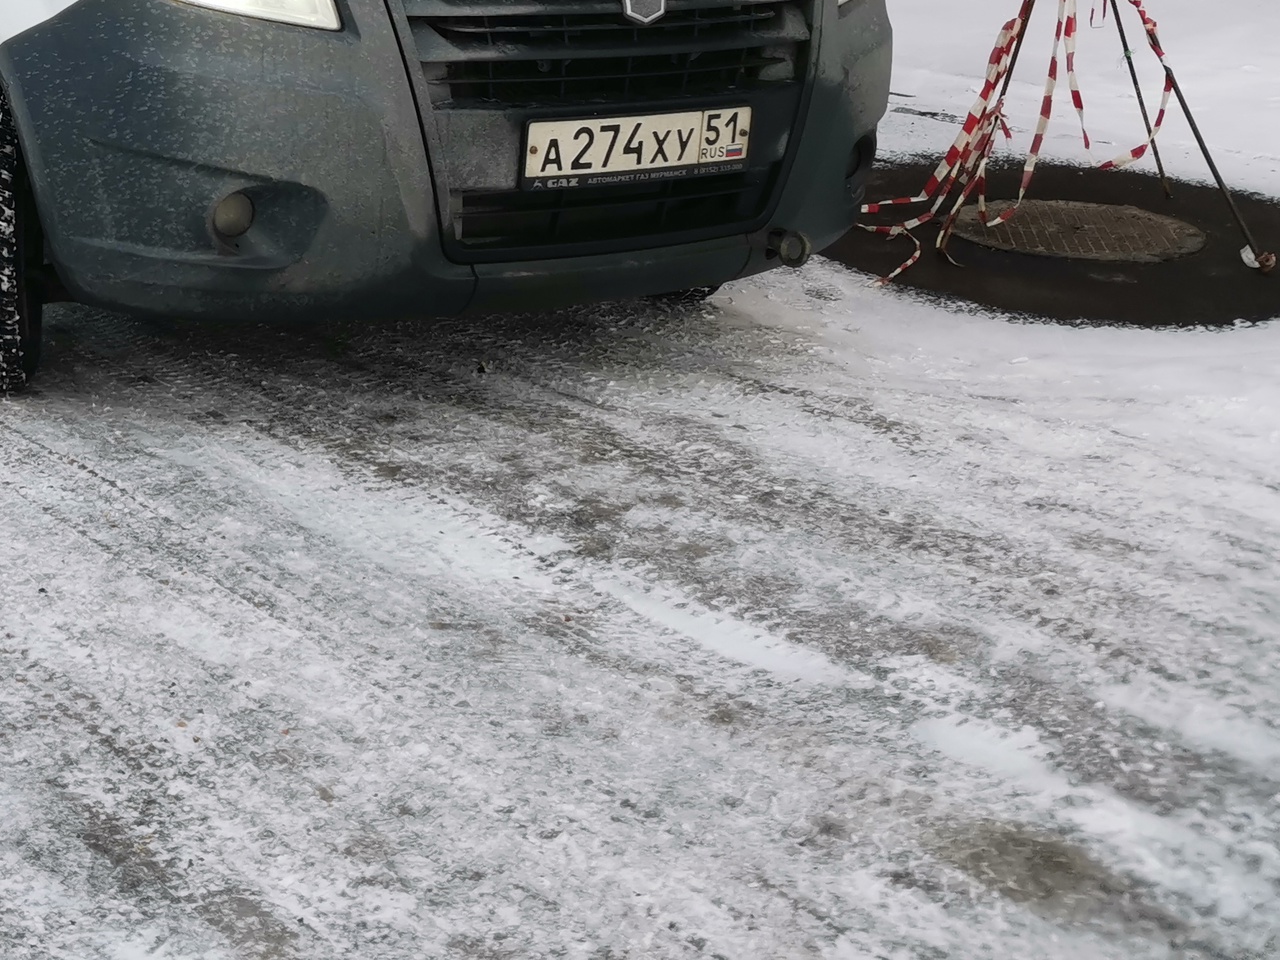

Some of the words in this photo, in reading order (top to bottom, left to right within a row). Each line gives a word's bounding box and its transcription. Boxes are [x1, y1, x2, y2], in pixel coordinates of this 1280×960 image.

[540, 122, 695, 173] А274ХУ
[705, 111, 738, 146] 51
[700, 146, 725, 160] RUS
[546, 178, 579, 189] GAZ
[587, 174, 635, 185] АВТОМАРКЕТ
[636, 172, 649, 181] ГАЗ
[650, 169, 687, 180] МУРМАНСК
